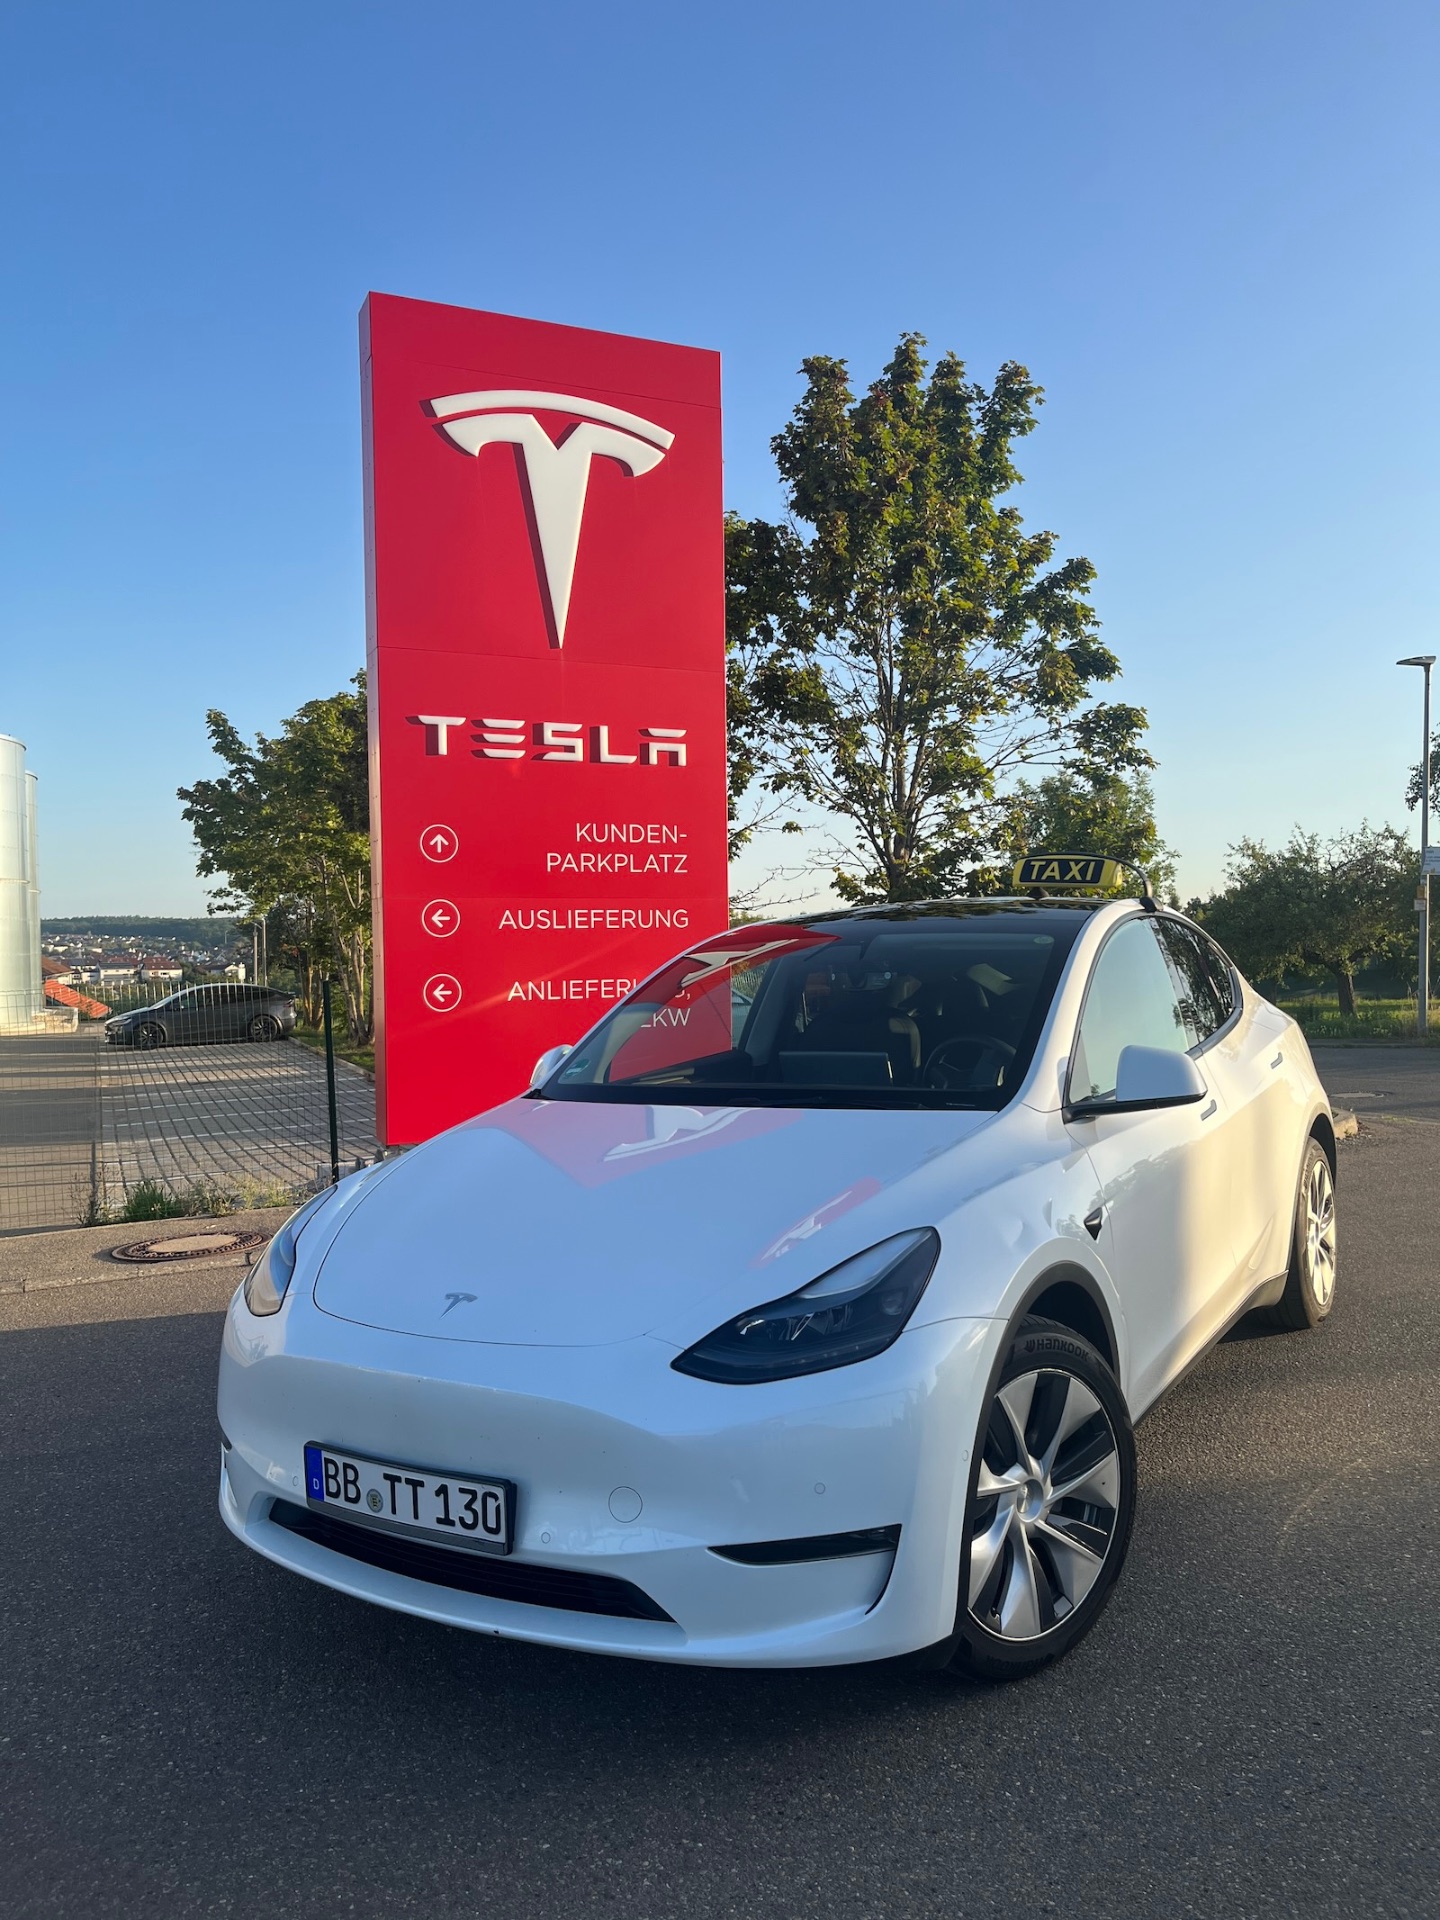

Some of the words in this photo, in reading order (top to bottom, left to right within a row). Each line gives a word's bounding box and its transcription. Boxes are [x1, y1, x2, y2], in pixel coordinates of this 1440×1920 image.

[418, 715, 687, 766] TESLA
[576, 823, 688, 844] KUNDEN-
[546, 853, 688, 874] PARKPLATZ
[1030, 861, 1096, 881] TAXI
[498, 909, 690, 930] AUSLIEFERUNG
[312, 1478, 320, 1490] D
[323, 1457, 362, 1504] BB
[383, 1472, 425, 1520] TT
[435, 1484, 500, 1535] 130
